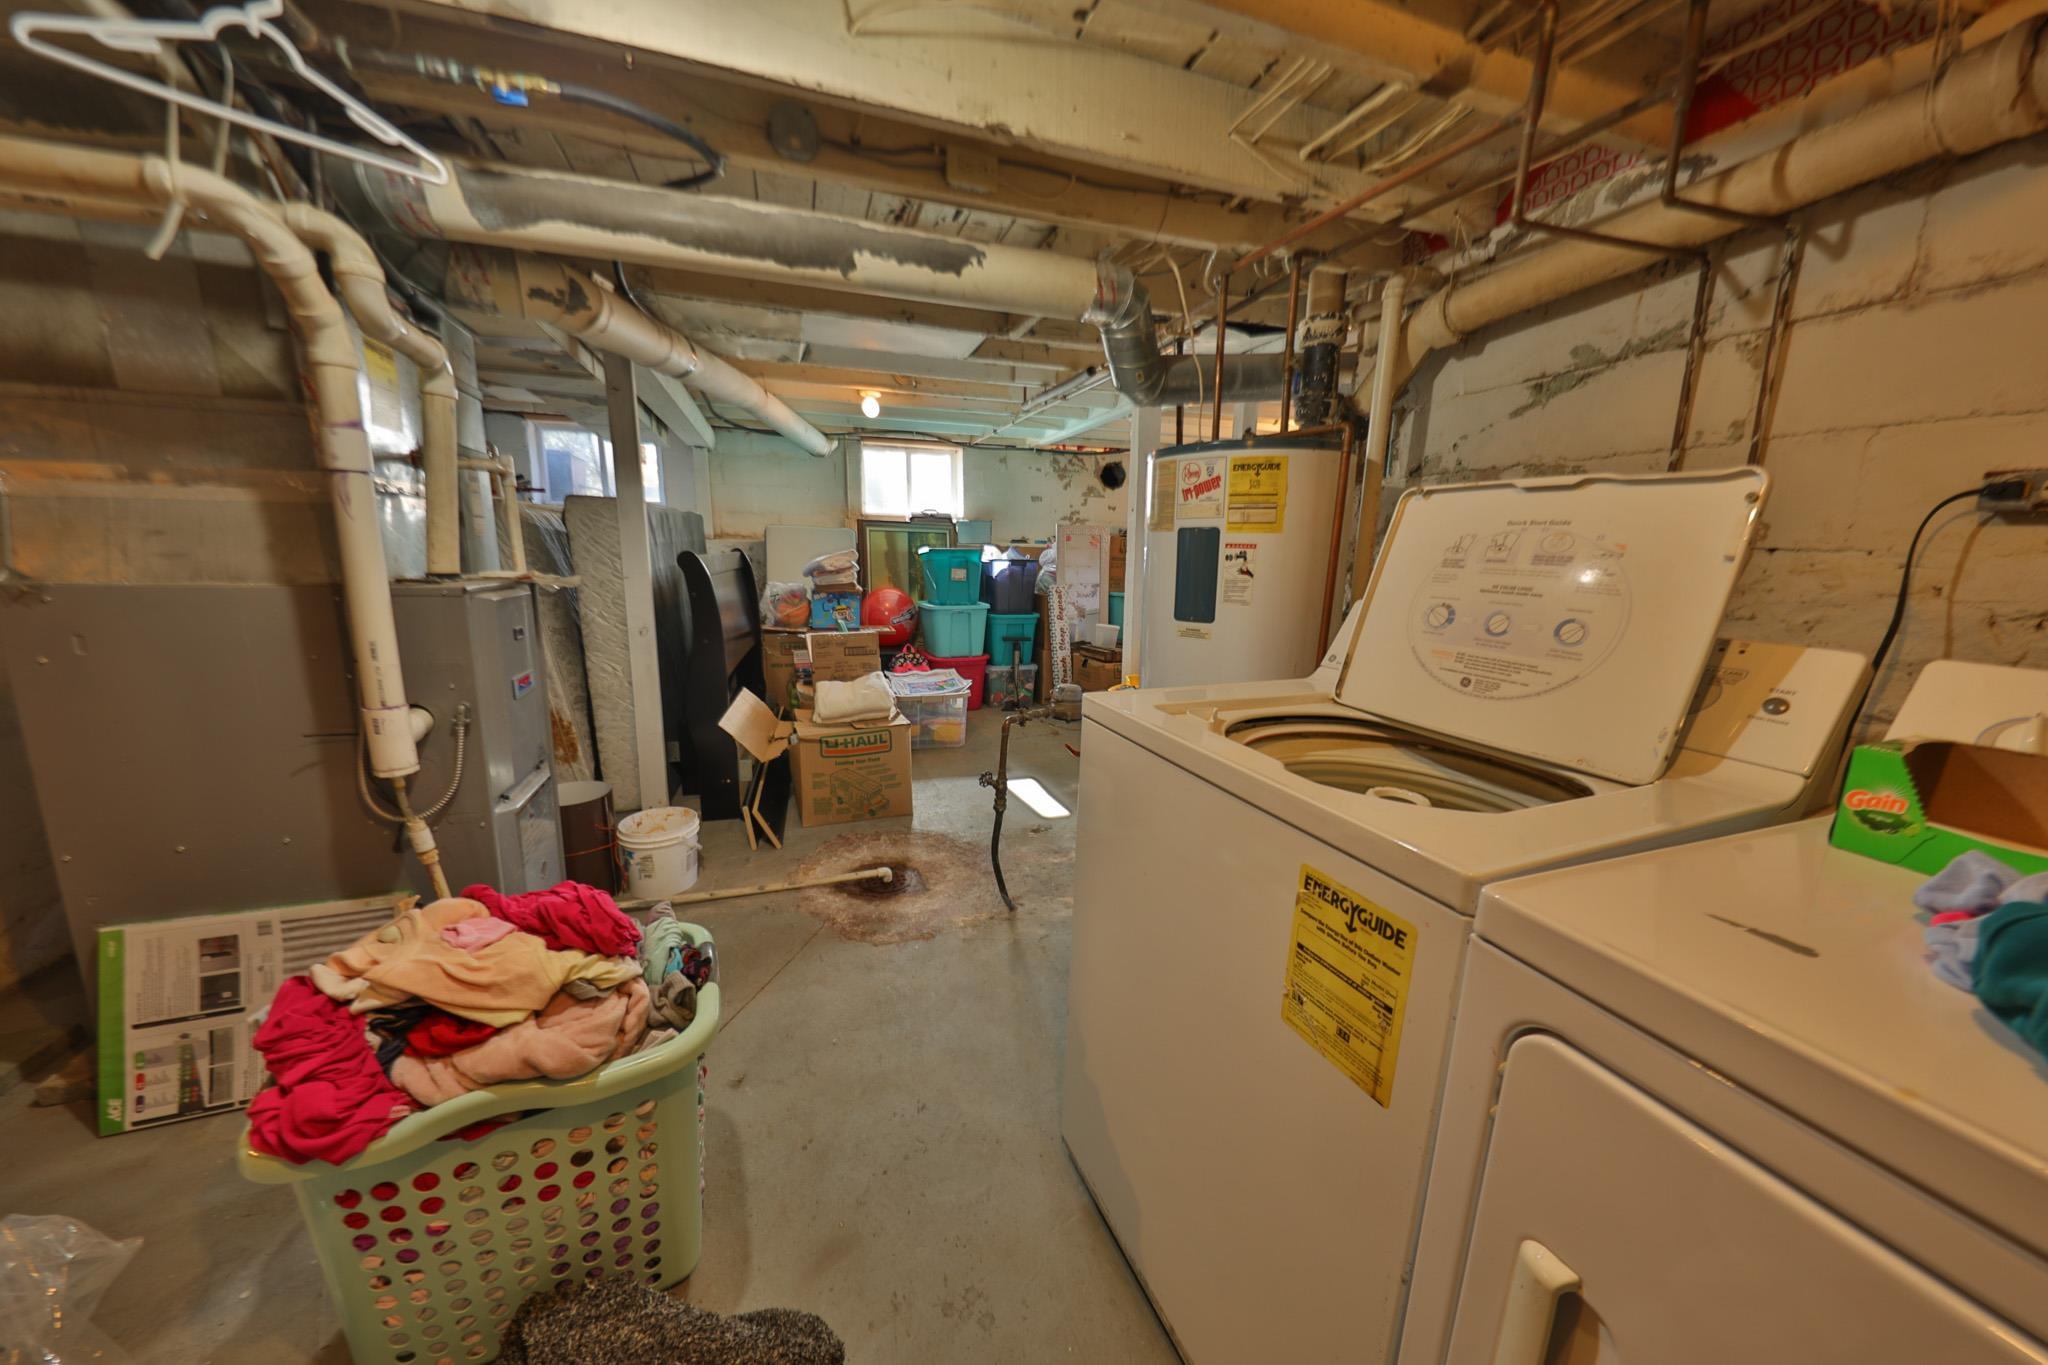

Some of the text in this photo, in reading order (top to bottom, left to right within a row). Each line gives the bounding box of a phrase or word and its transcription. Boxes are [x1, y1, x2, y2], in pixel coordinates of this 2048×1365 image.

[824, 734, 887, 748] U-HAUL
[1844, 789, 1908, 815] Gain
[1304, 874, 1408, 951] ENERGYGUIDE
